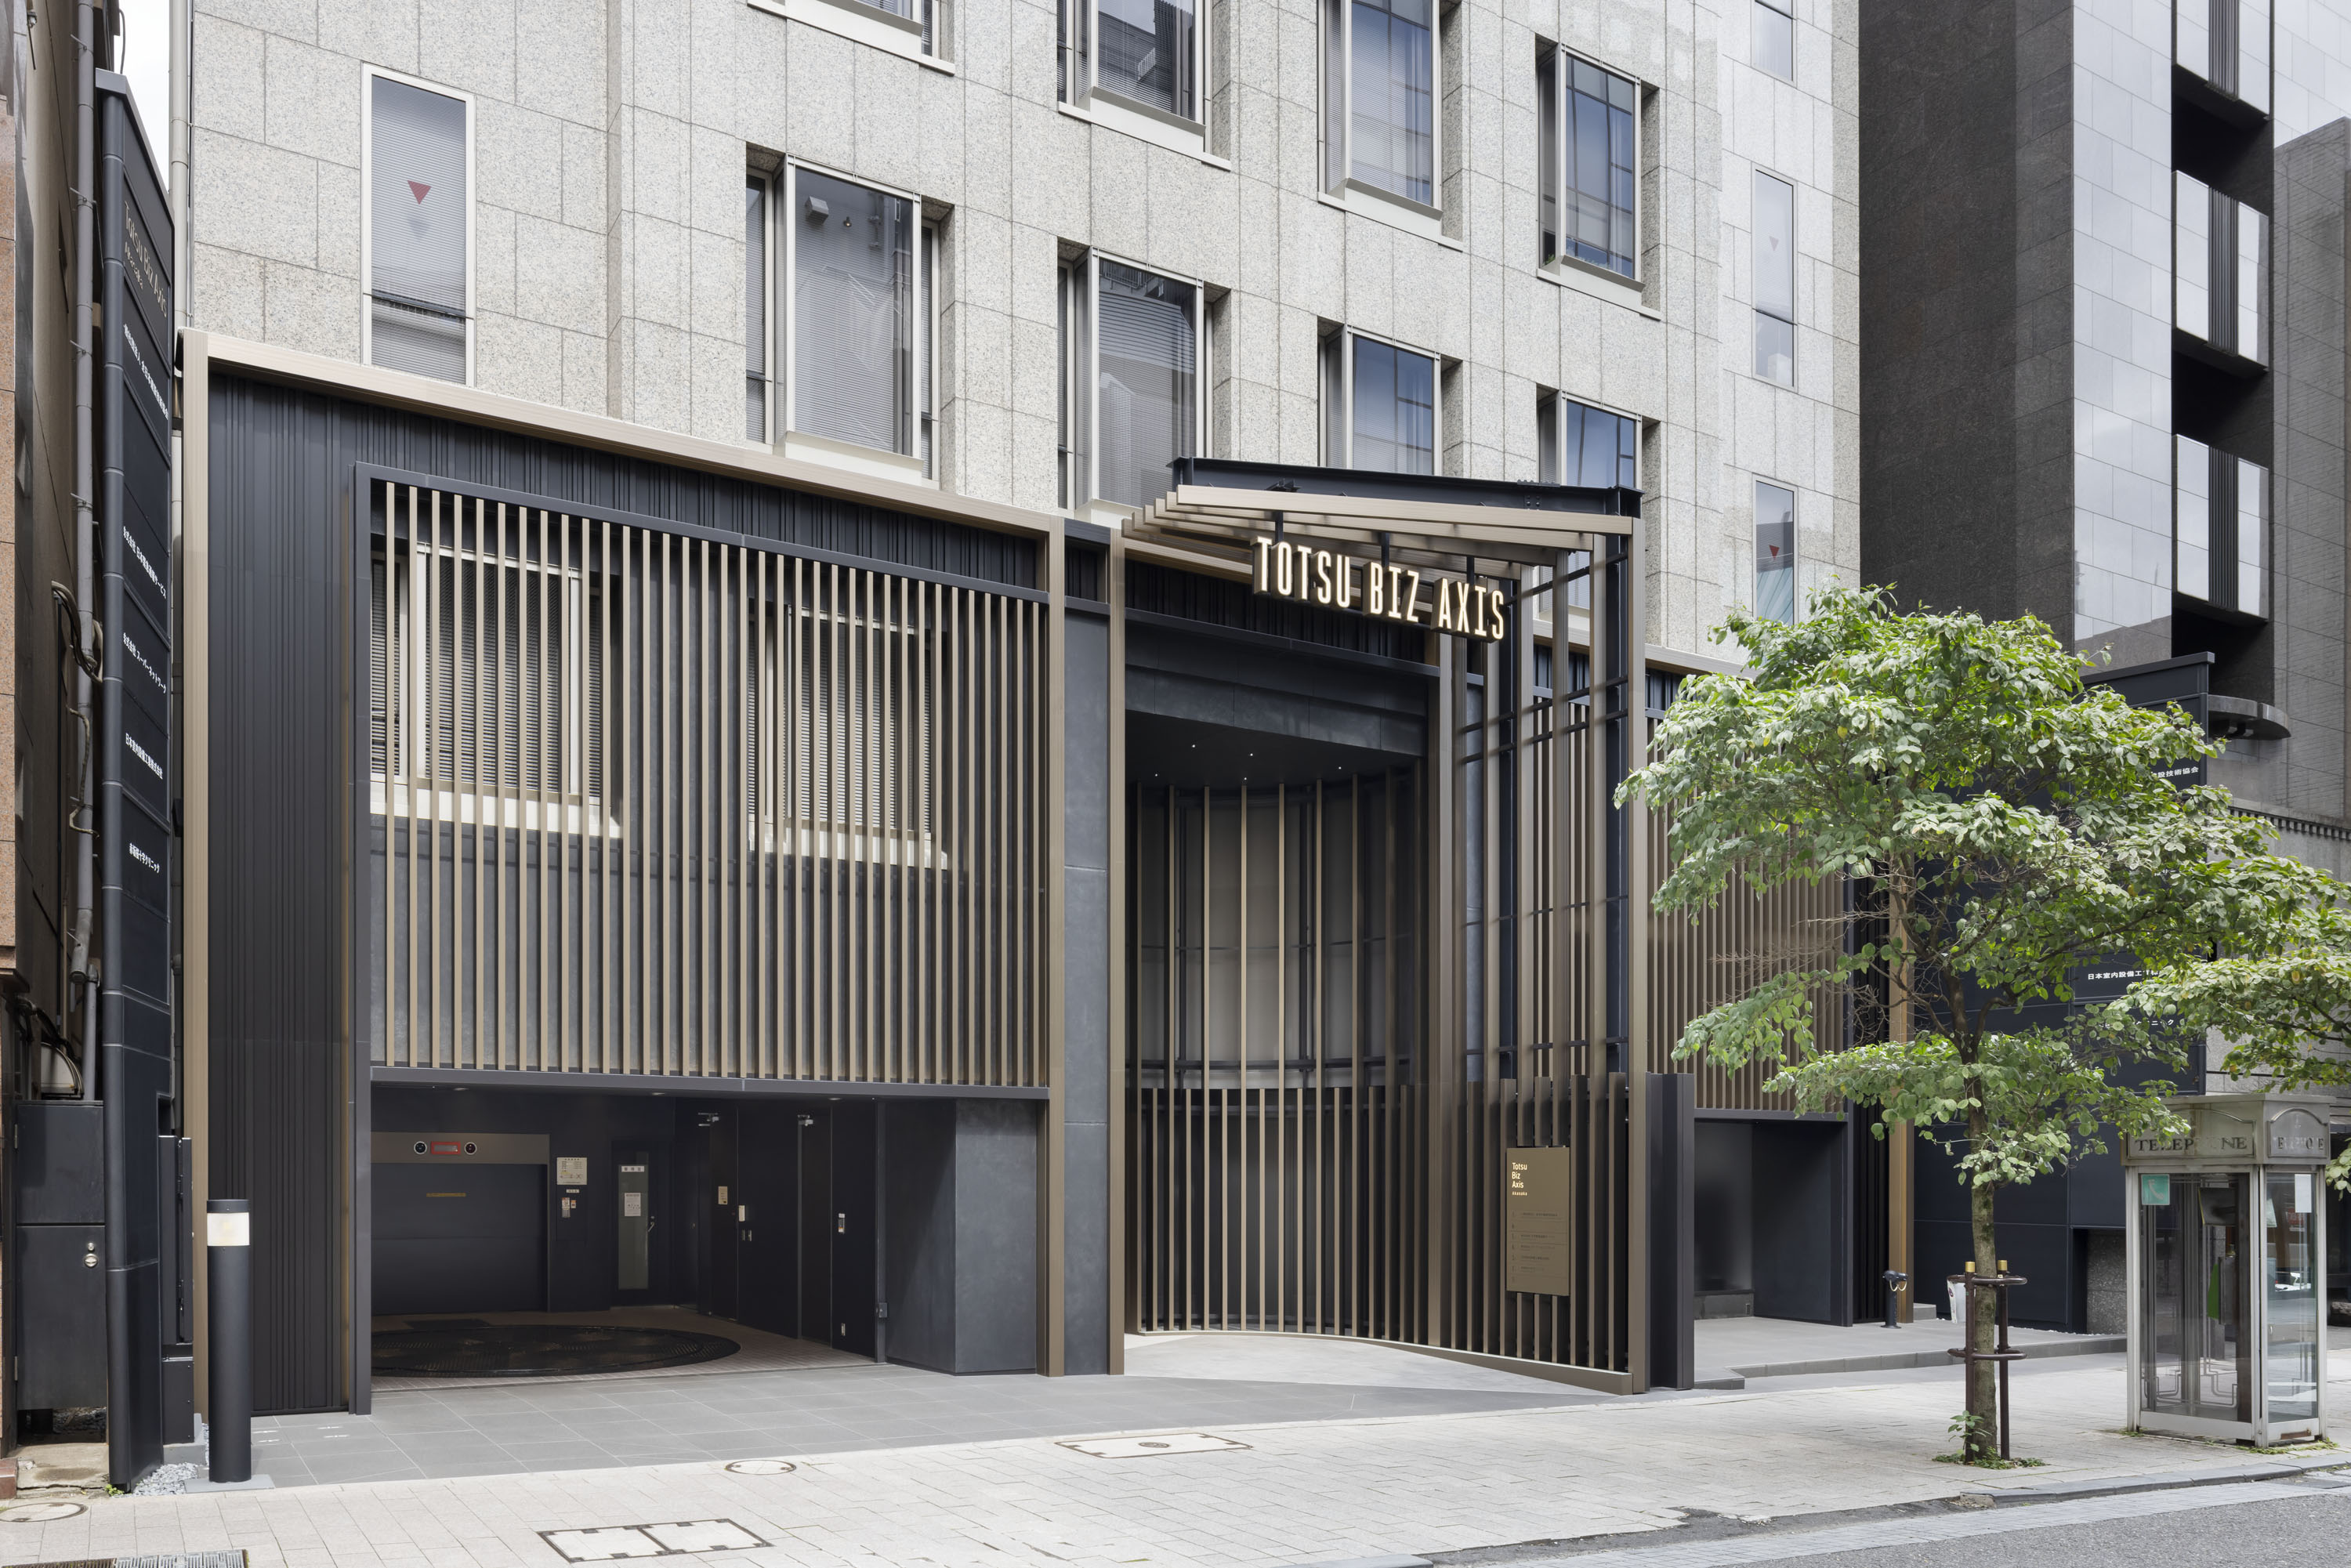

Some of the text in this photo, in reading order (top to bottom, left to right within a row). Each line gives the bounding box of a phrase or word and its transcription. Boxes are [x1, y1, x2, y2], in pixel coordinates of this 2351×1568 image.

[125, 201, 167, 317] Totsu Biz Axis
[123, 526, 136, 553] 株式会社
[1252, 536, 1505, 642] TOTSU BIZ AXIS
[123, 632, 166, 693] 株式会社 スーパーネットワーク
[125, 733, 163, 780] 日本室内設備工業株式会社
[1512, 1162, 1527, 1171] Totsu
